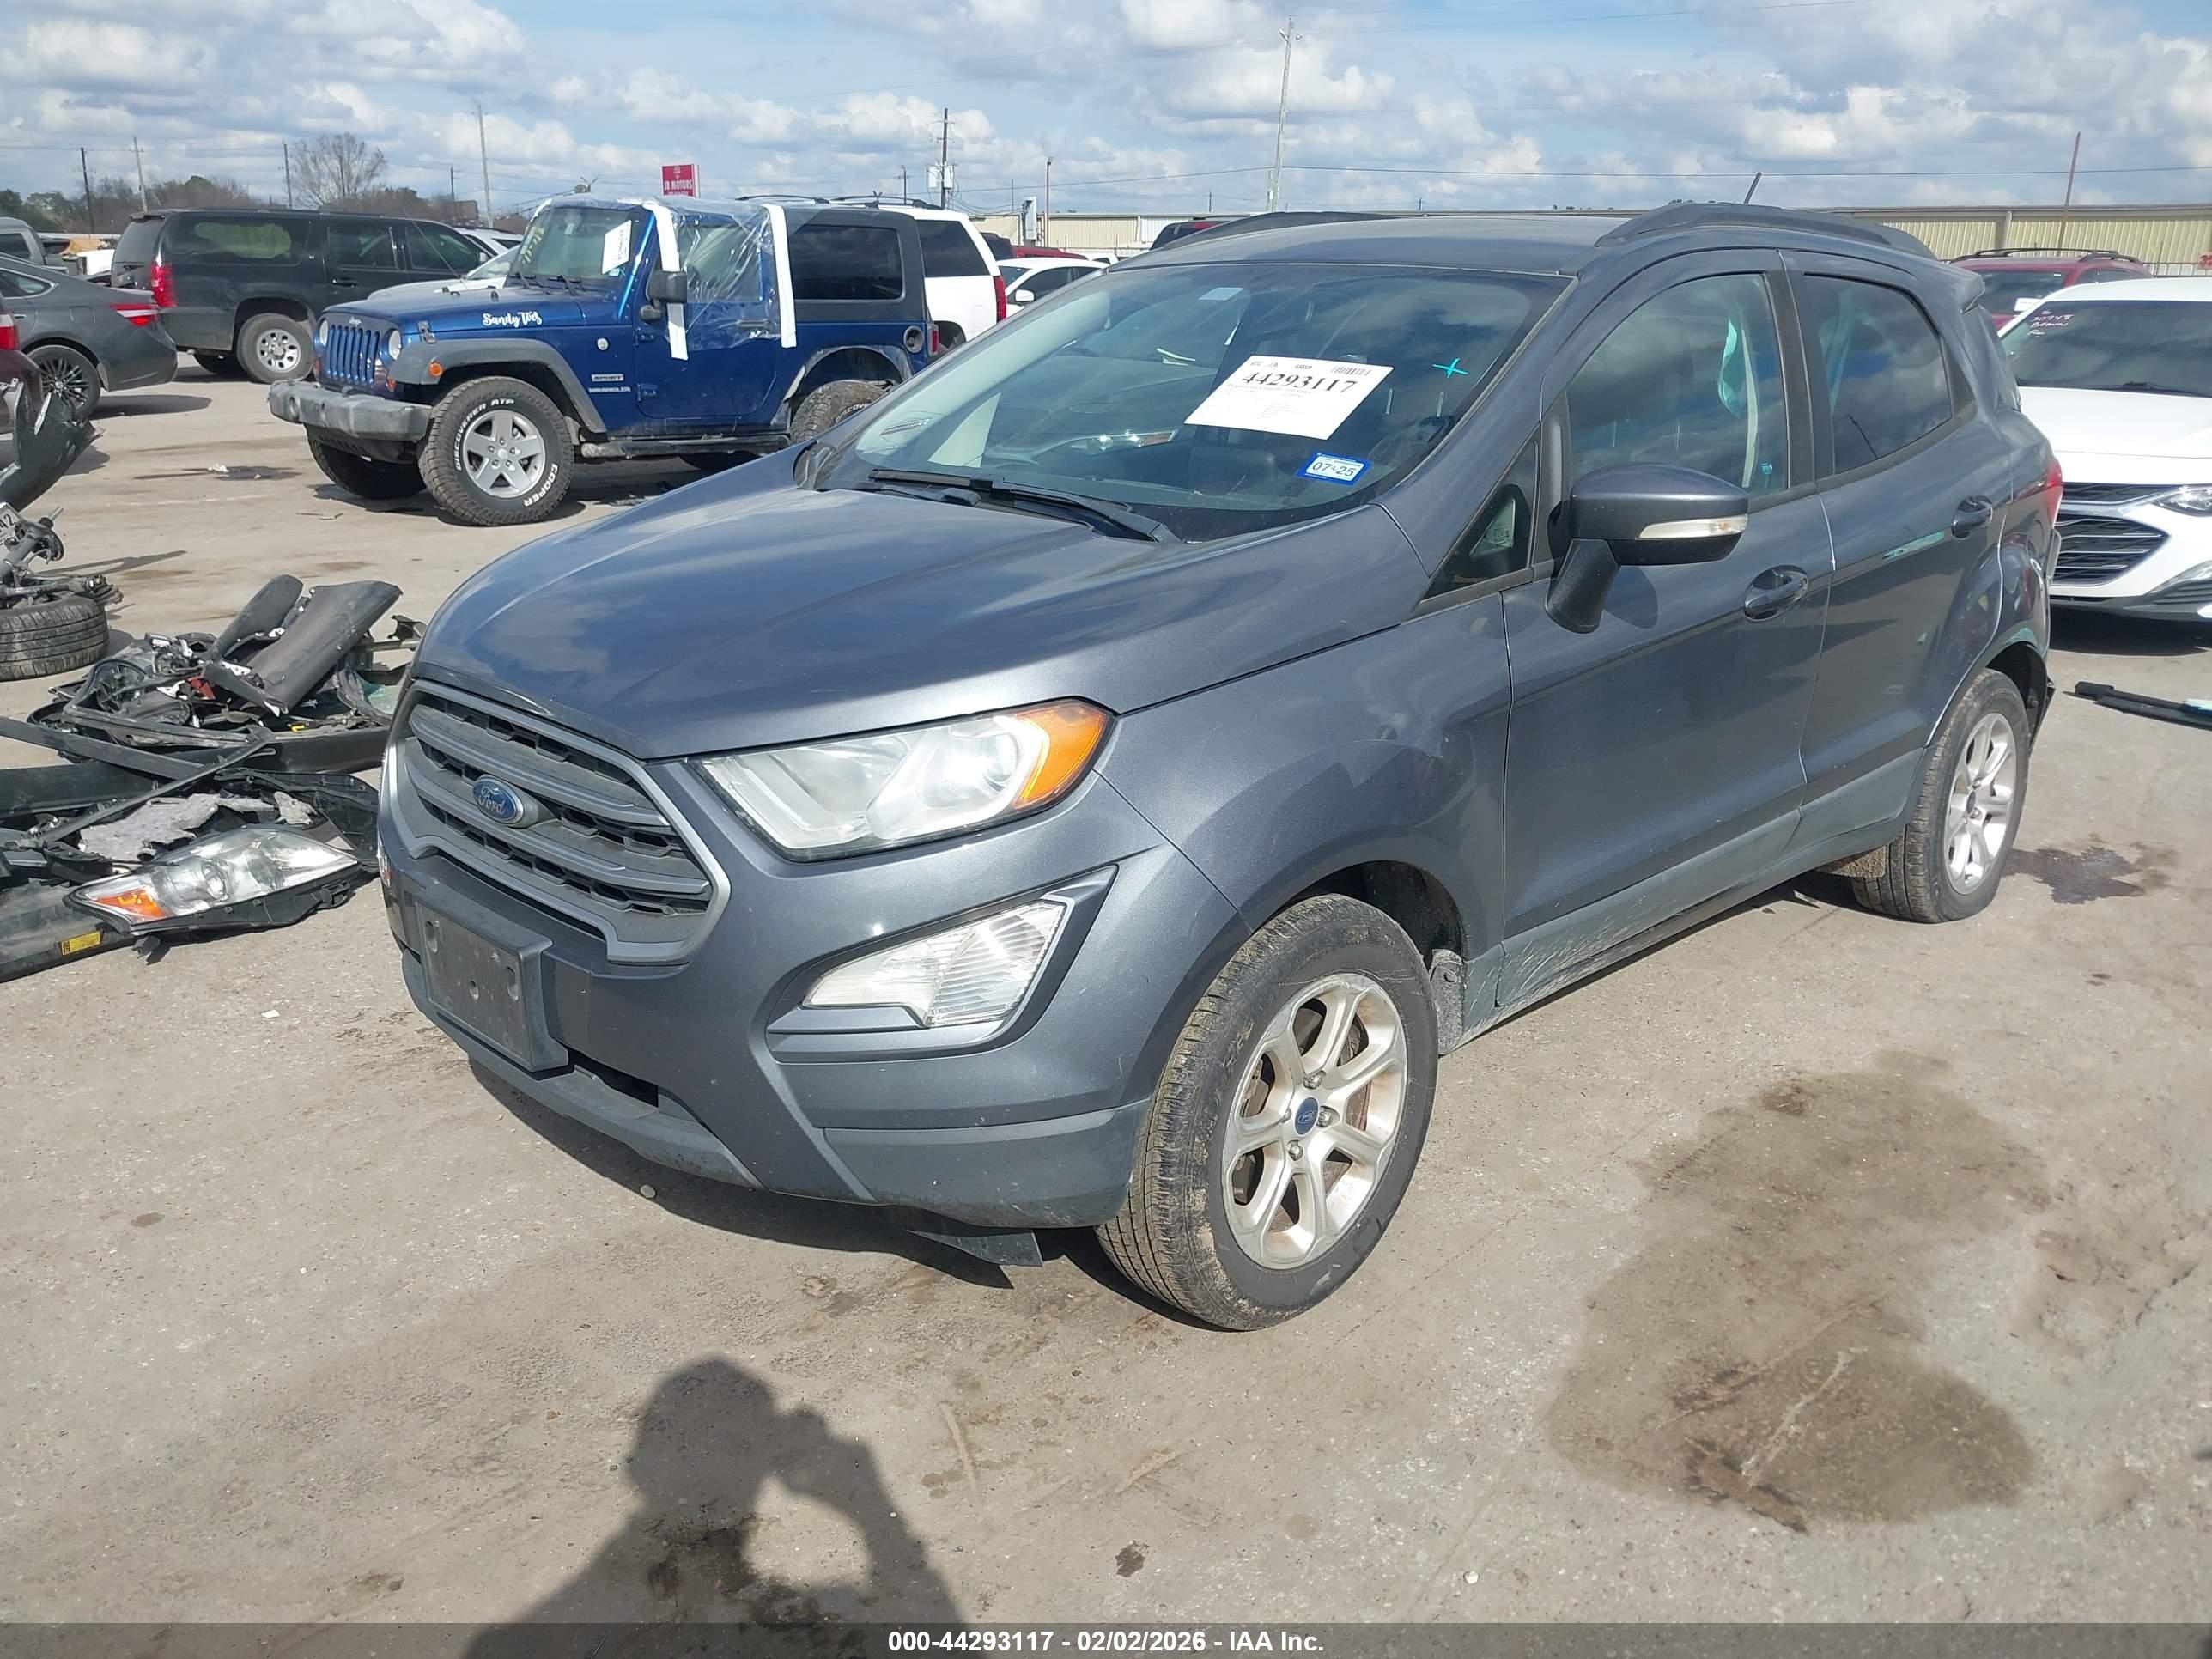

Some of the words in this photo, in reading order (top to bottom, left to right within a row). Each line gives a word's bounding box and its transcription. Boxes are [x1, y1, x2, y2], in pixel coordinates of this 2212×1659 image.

[483, 313, 520, 328] Sandy
[1242, 372, 1358, 393] 44293117
[453, 403, 487, 471] DISCOVERER
[522, 463, 558, 507] COOPER
[477, 785, 507, 815] Ford
